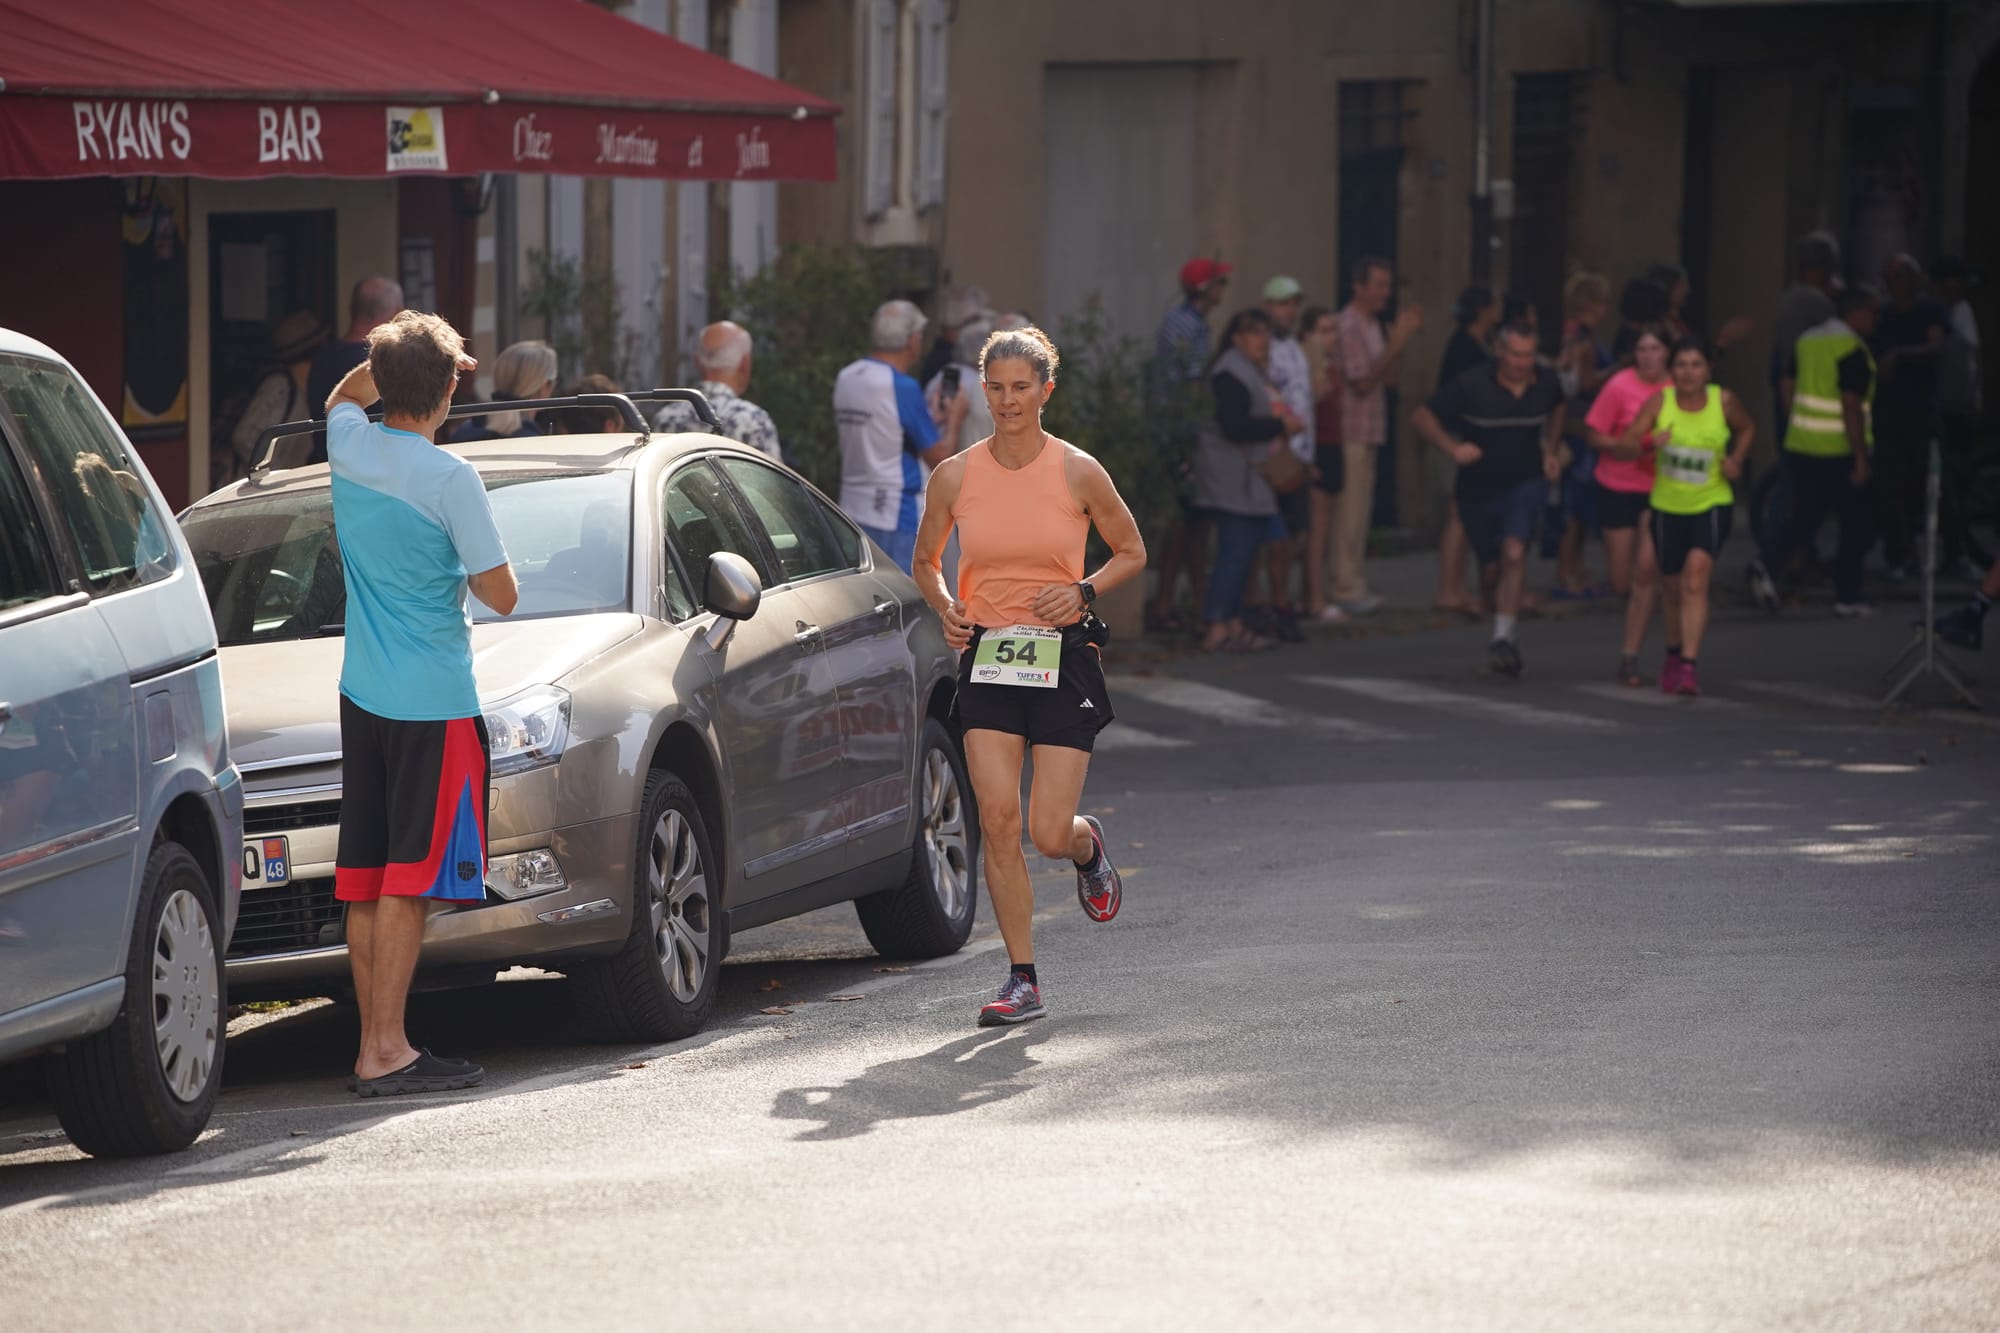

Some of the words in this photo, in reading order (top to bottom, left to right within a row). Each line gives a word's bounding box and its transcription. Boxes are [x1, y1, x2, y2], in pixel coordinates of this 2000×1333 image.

[73, 101, 191, 161] RYAN'S
[258, 106, 323, 163] BAR
[513, 112, 553, 162] Chez
[595, 122, 659, 167] Martine
[687, 134, 703, 168] et
[736, 125, 770, 177] John
[995, 640, 1037, 665] 54
[267, 861, 285, 879] 48
